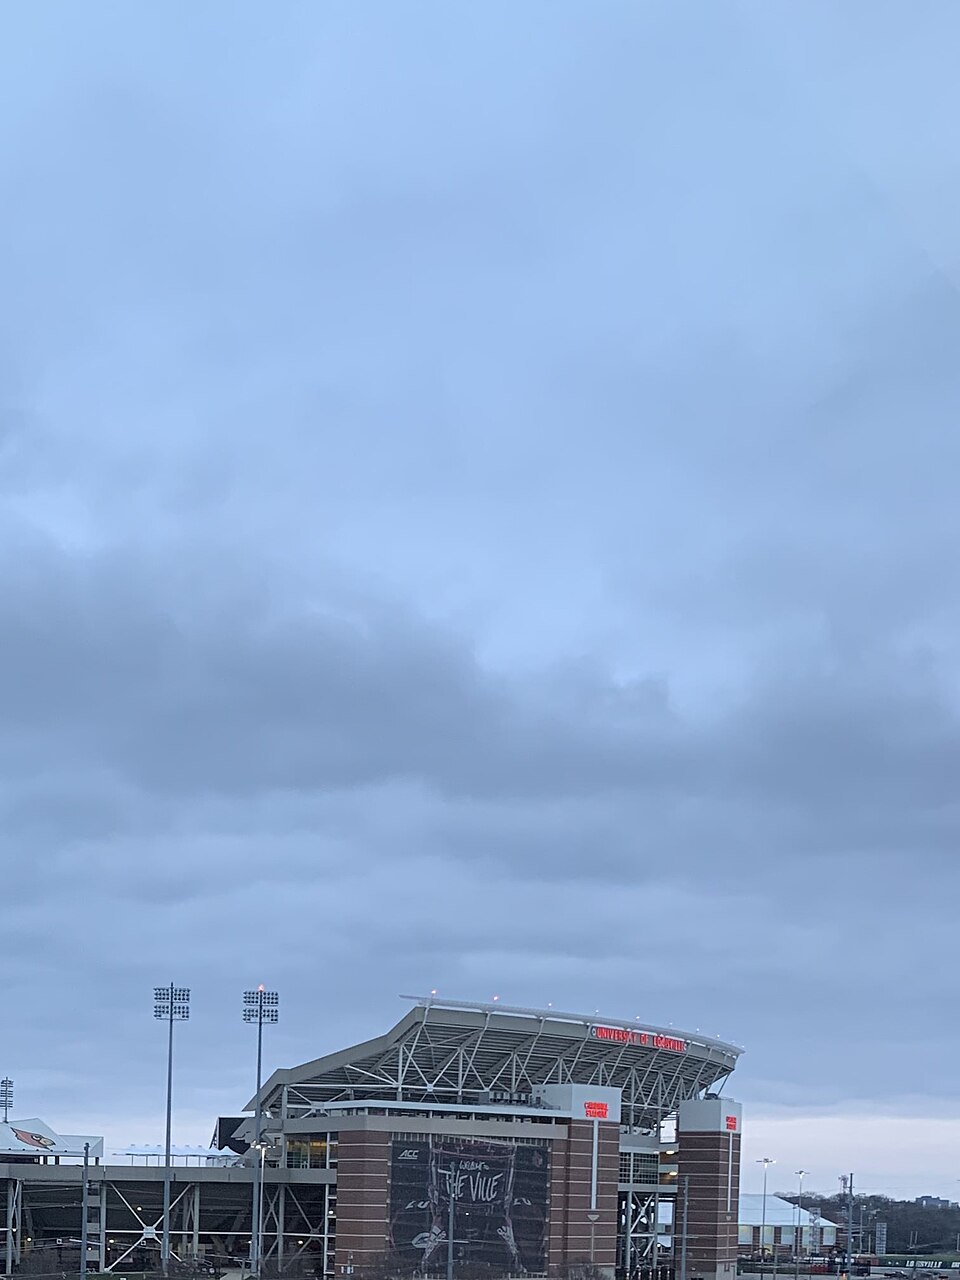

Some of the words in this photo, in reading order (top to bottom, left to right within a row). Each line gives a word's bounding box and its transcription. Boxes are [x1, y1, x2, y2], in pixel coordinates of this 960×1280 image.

[641, 1034, 649, 1045] OF
[400, 1150, 419, 1158] ACC
[438, 1168, 469, 1200] THE
[469, 1171, 504, 1201] VILLE
